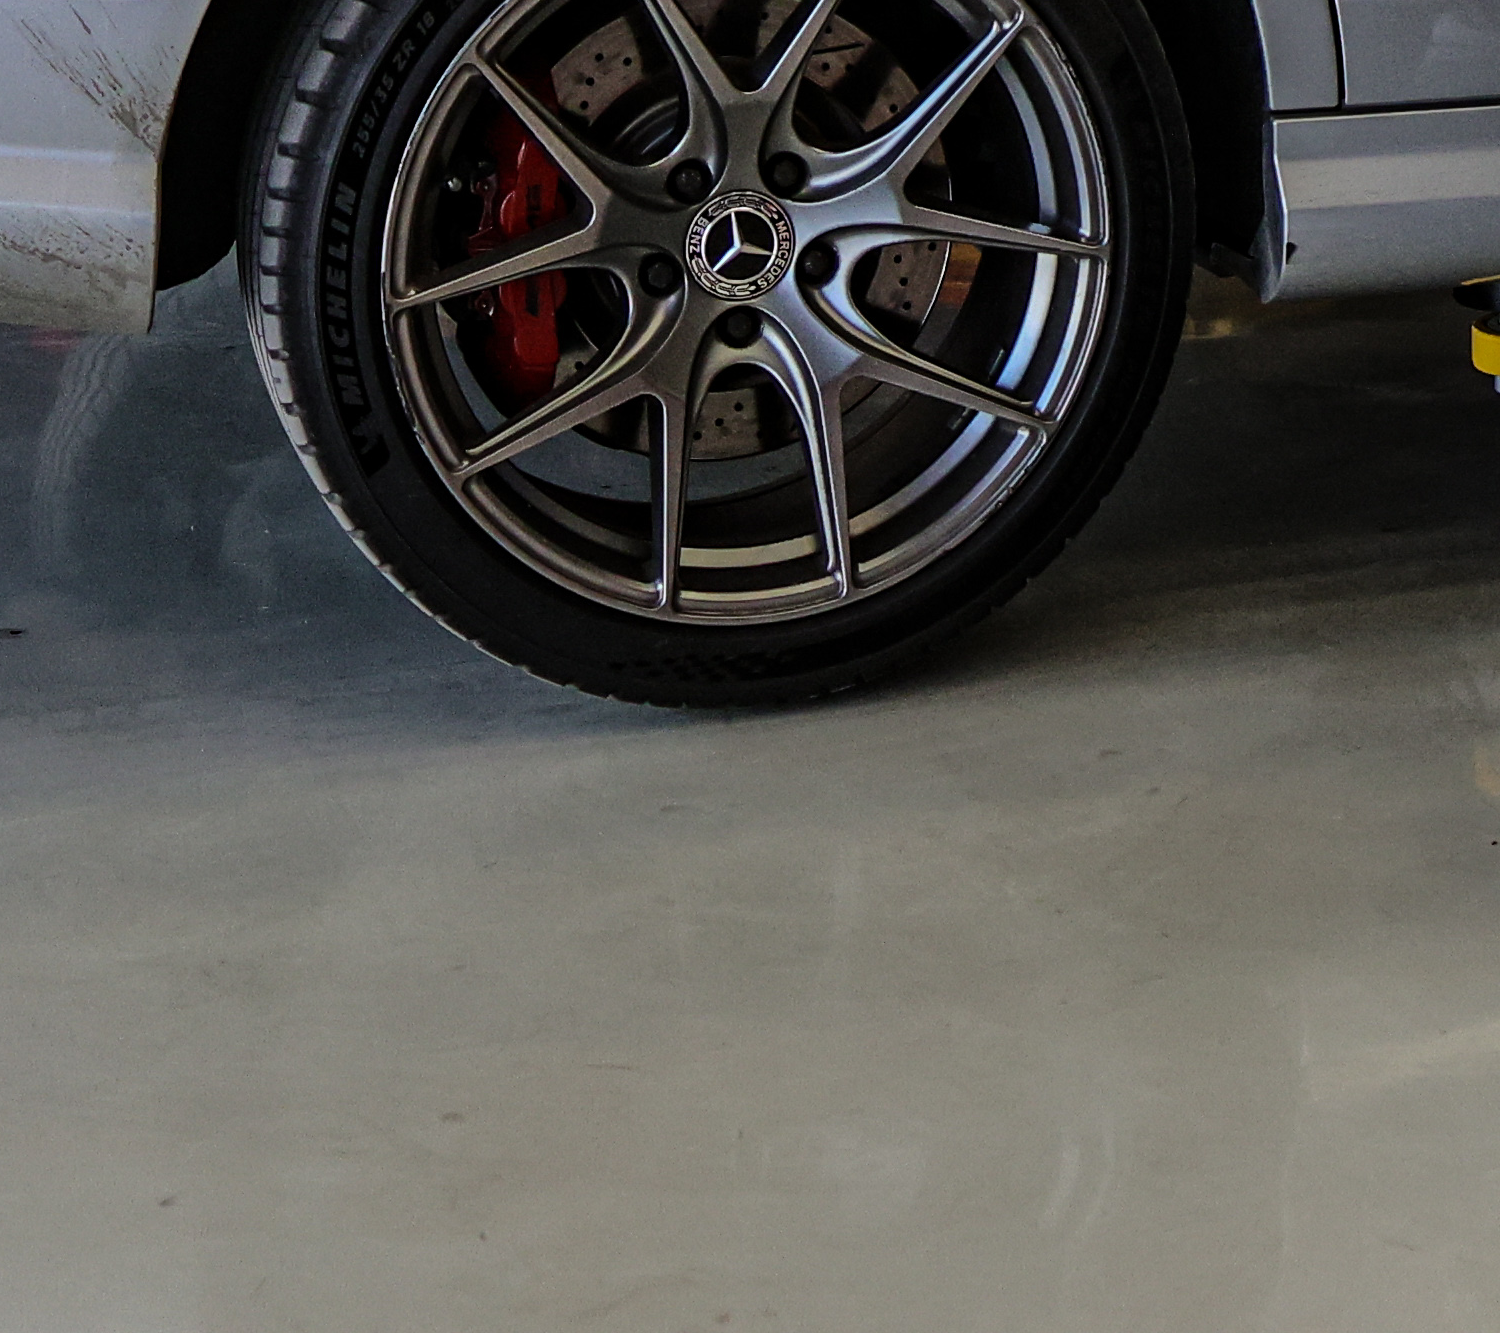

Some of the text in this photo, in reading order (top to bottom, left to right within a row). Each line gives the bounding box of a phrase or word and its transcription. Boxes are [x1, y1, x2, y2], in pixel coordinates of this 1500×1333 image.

[325, 8, 438, 411] MICHELIN 255/35 ZR 18
[689, 216, 710, 254] BENZ
[757, 220, 790, 289] MERCEDES
